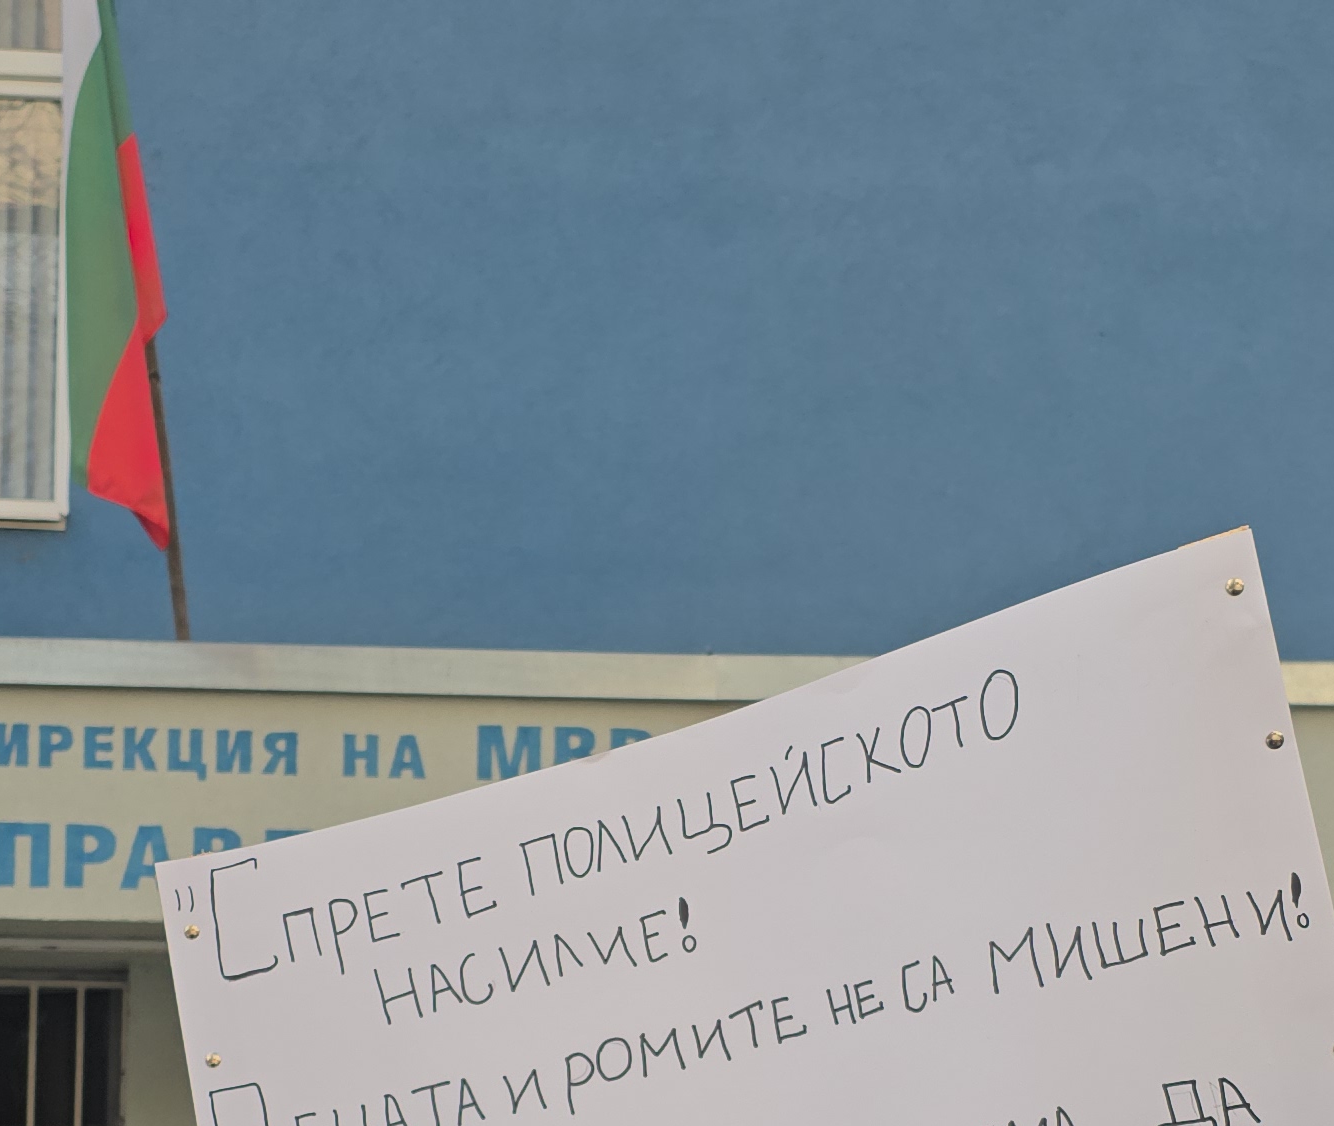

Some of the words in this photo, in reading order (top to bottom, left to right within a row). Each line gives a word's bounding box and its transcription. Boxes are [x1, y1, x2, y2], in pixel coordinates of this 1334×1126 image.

[342, 733, 427, 780] НА
[519, 668, 1019, 896] ПОЛИЦЕЙСКОТО
[373, 896, 698, 1025] НАСИЛИЕ!
[503, 1068, 547, 1114] И
[565, 996, 807, 1115] РОМИТЕ
[827, 980, 884, 1025] НЕ
[901, 955, 955, 1013] СА
[988, 871, 1310, 995] МИШЕНИ!
